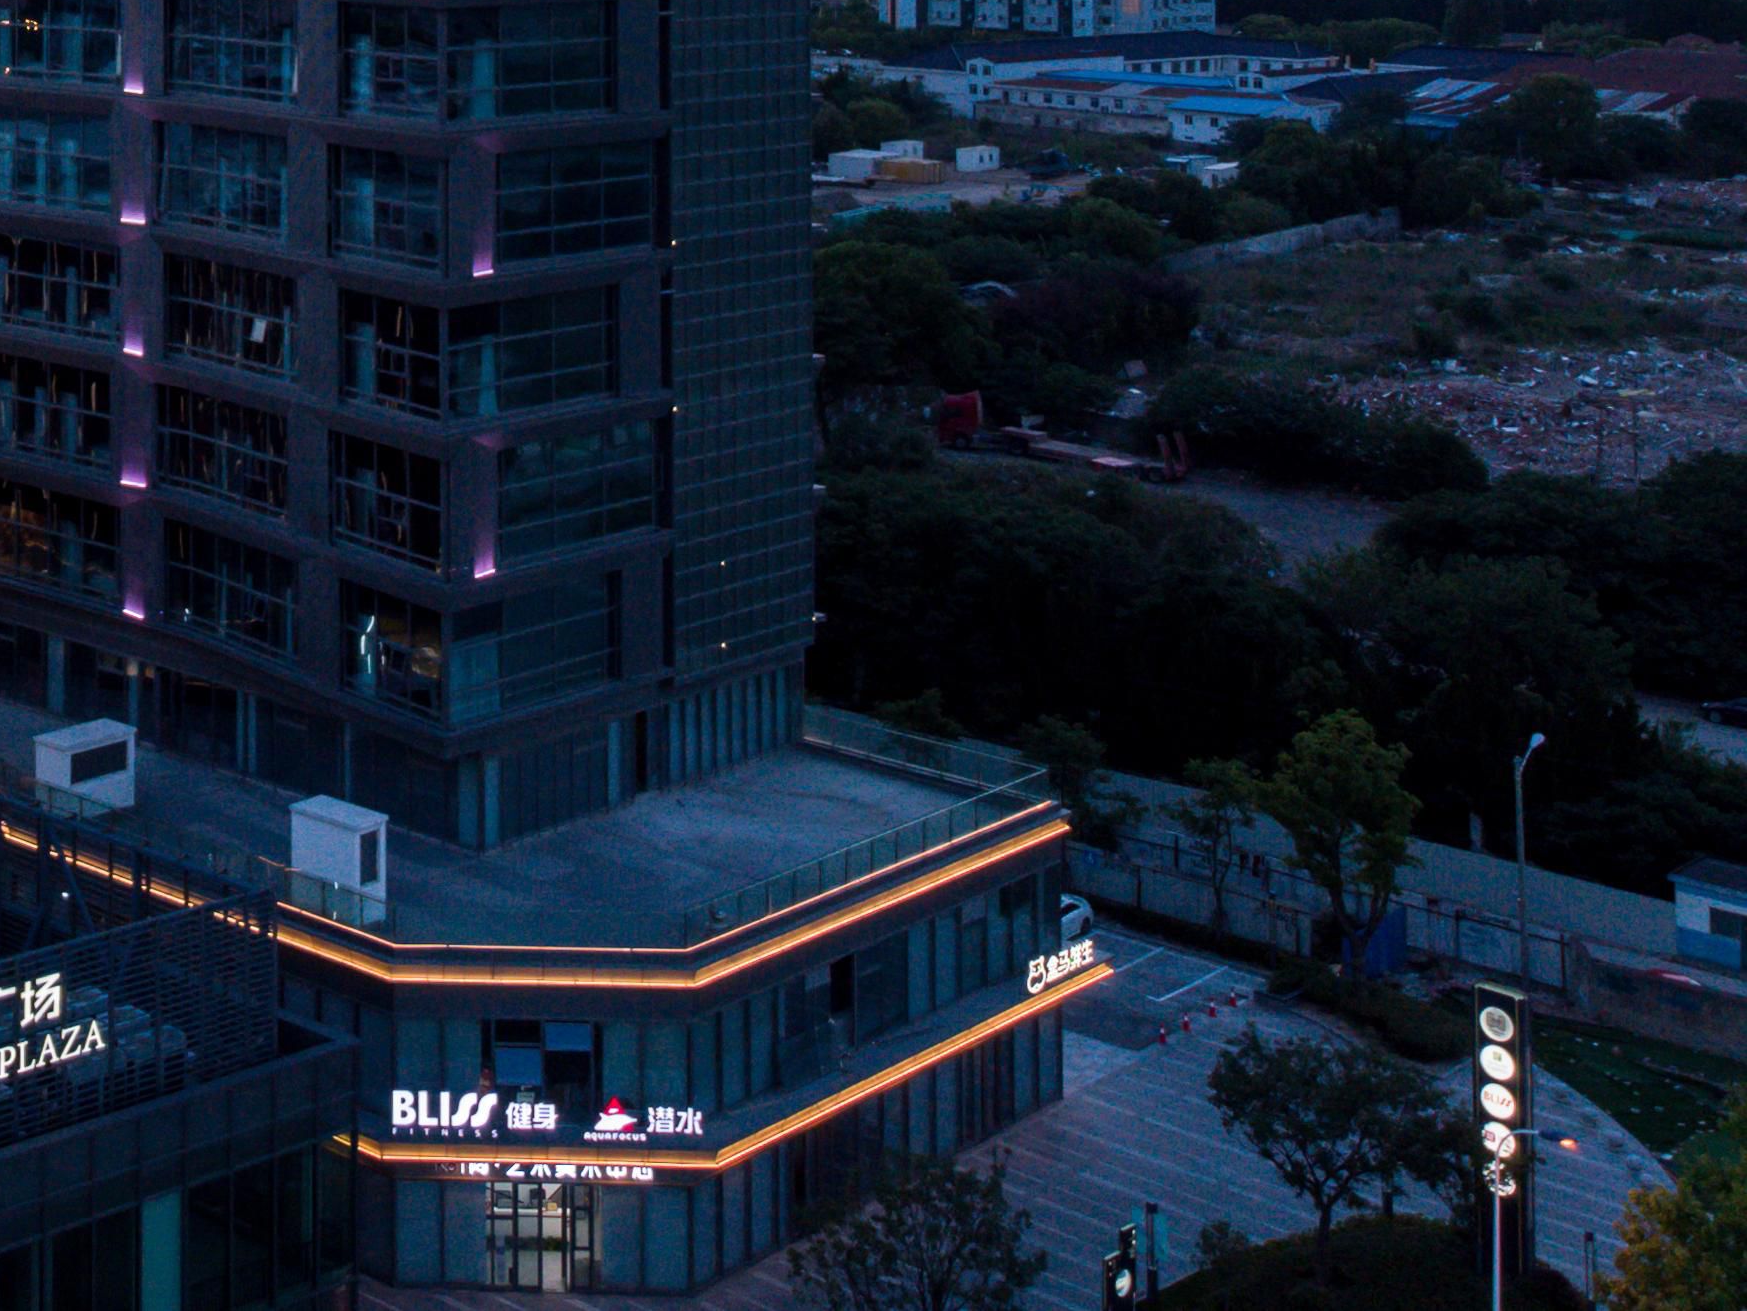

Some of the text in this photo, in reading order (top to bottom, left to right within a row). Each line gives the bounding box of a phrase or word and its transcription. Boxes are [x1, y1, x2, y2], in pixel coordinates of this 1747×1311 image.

[392, 1090, 498, 1128] BLISS
[505, 1101, 559, 1130] 健身
[646, 1106, 704, 1135] 潜水
[391, 1127, 499, 1139] FITNESS
[583, 1131, 647, 1142] AQUAFOCUS
